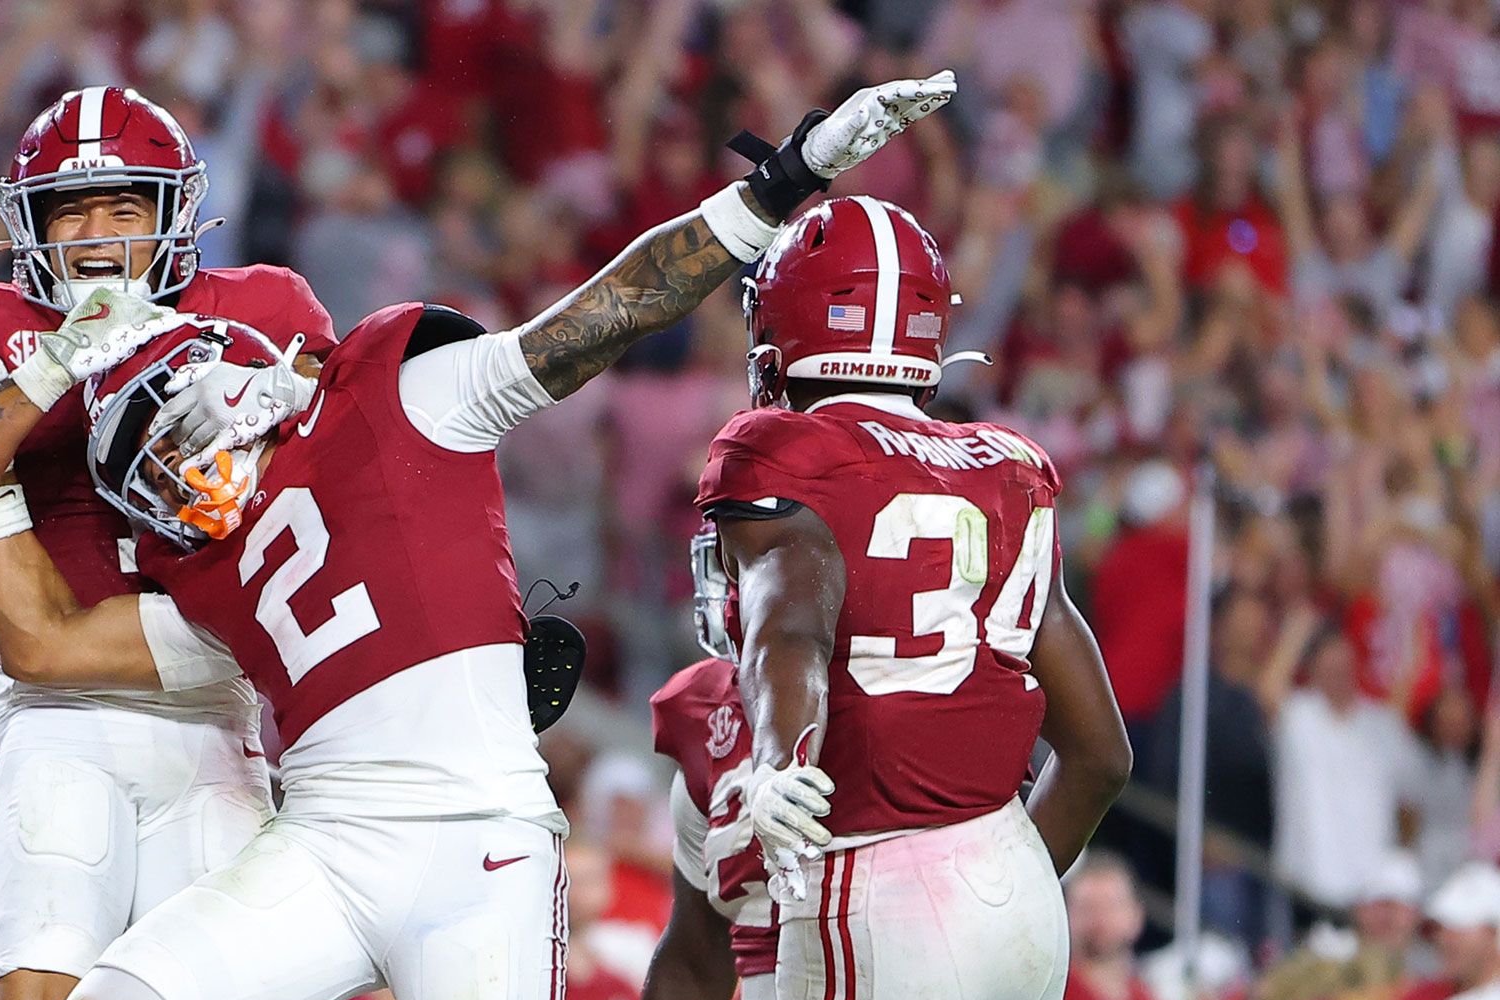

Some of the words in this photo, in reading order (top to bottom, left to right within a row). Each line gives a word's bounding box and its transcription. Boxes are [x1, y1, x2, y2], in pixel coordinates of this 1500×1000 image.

[6, 330, 41, 368] SE
[820, 361, 898, 378] CRIMSON
[902, 366, 932, 383] TIDE
[237, 486, 382, 688] 2
[846, 492, 1055, 696] 34
